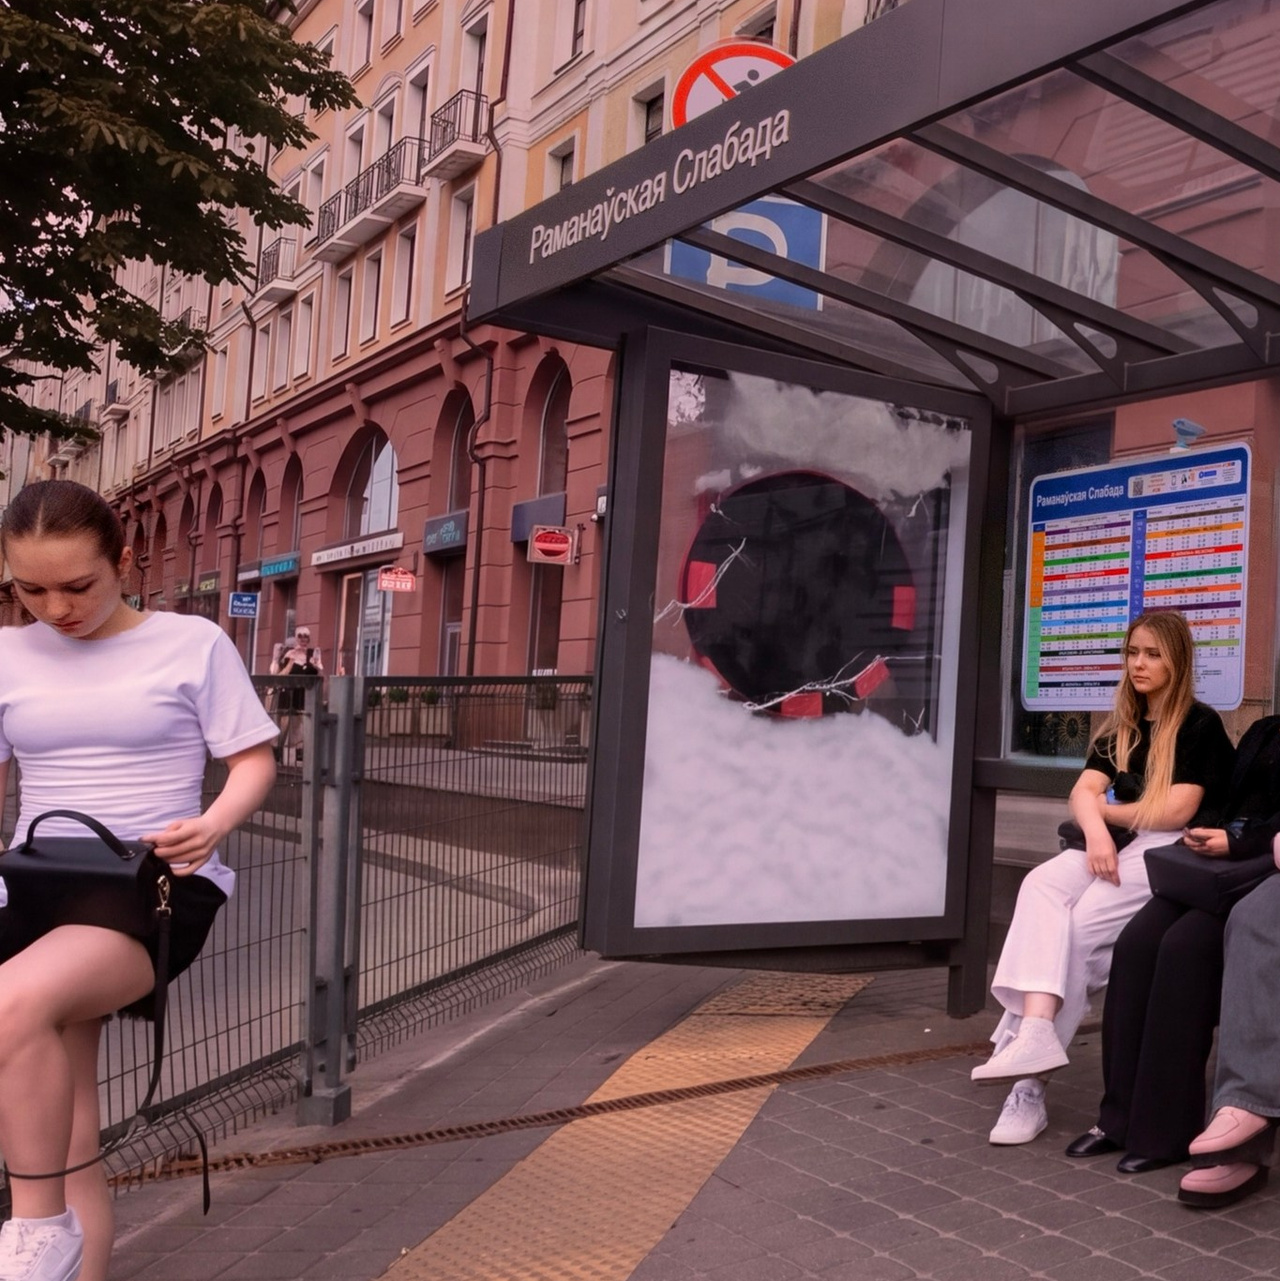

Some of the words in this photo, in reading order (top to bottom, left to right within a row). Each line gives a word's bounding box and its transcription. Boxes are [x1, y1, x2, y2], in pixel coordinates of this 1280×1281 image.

[529, 172, 665, 264] Раманаўская
[674, 109, 789, 194] Слабада
[1036, 490, 1087, 508] Раманаўская
[1087, 484, 1125, 500] Слабада
